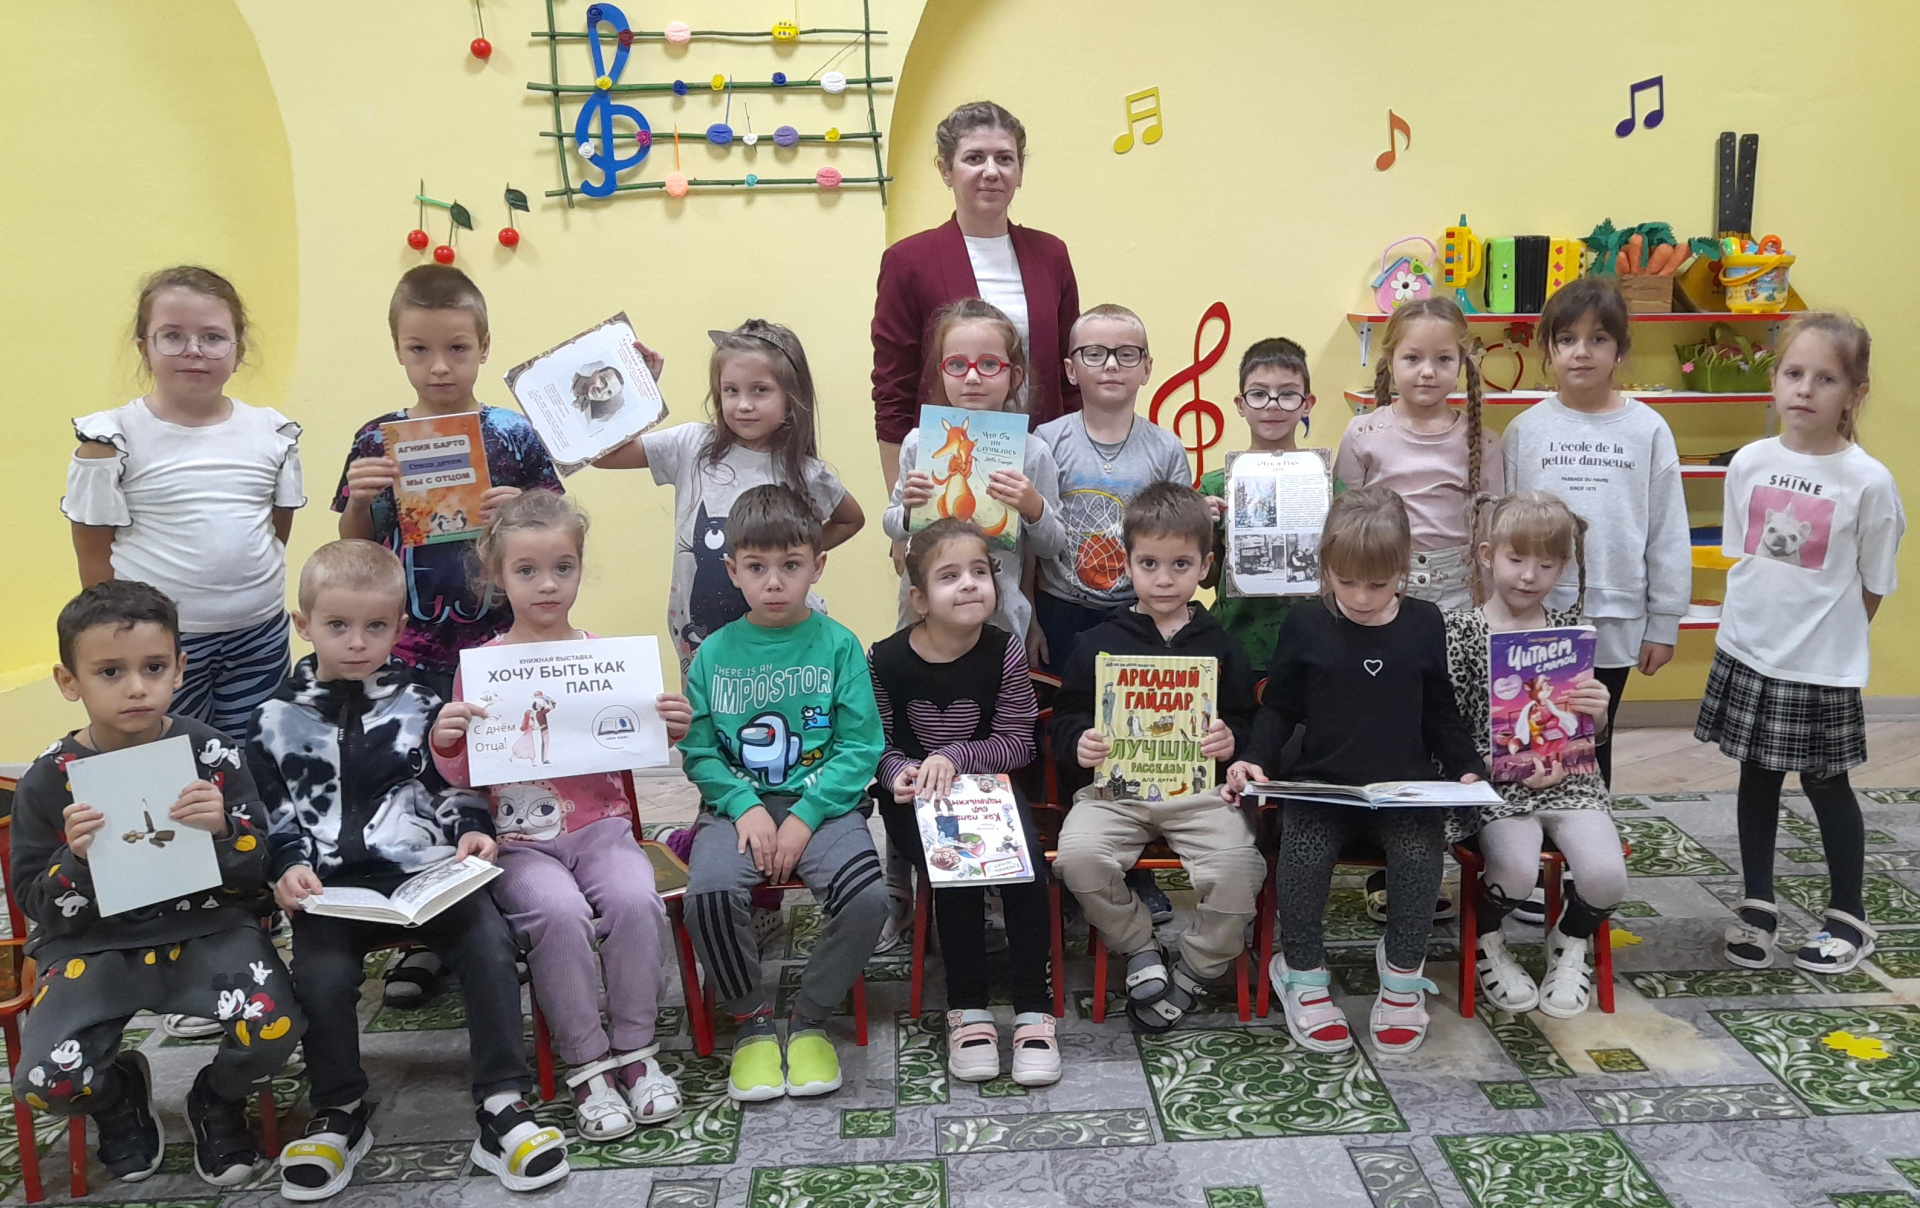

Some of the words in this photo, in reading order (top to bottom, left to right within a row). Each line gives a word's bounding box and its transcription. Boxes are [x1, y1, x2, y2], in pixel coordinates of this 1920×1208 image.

[982, 430, 997, 439] Что
[999, 432, 1011, 441] бы
[398, 443, 431, 454] АГНИЯ
[433, 439, 466, 450] БАРТО
[976, 446, 1017, 456] случилось
[1595, 442, 1610, 453] de
[1613, 443, 1624, 454] la
[1542, 455, 1576, 469] petite
[1578, 455, 1636, 470] danseuse
[406, 477, 424, 487] МЫ
[426, 475, 433, 484] С
[435, 472, 470, 484] ОТЦОМ
[1769, 474, 1823, 496] SHINE
[519, 656, 554, 665] КНИЖНАЯ
[555, 654, 593, 662] ВЫСТАВКА
[1507, 638, 1573, 672] Читаем
[1543, 652, 1578, 672] мамой
[488, 666, 535, 684] ХОЧУ
[539, 663, 589, 679] БЫТЬ
[594, 660, 625, 675] КАК
[714, 663, 743, 678] THERE
[746, 667, 756, 677] IS
[759, 663, 773, 672] AN
[1116, 666, 1200, 690] АРКАДИЙ
[566, 679, 613, 694] ПАПА
[711, 665, 832, 714] IMPOSTOR
[1124, 688, 1194, 713] ГАЙДАР
[473, 725, 482, 735] С
[486, 723, 516, 736] днём
[475, 737, 508, 752] Отца!
[1130, 762, 1186, 774] РАССКАЗЫ
[951, 797, 1002, 806] маленьким
[971, 805, 989, 814] был
[983, 812, 1001, 822] Как
